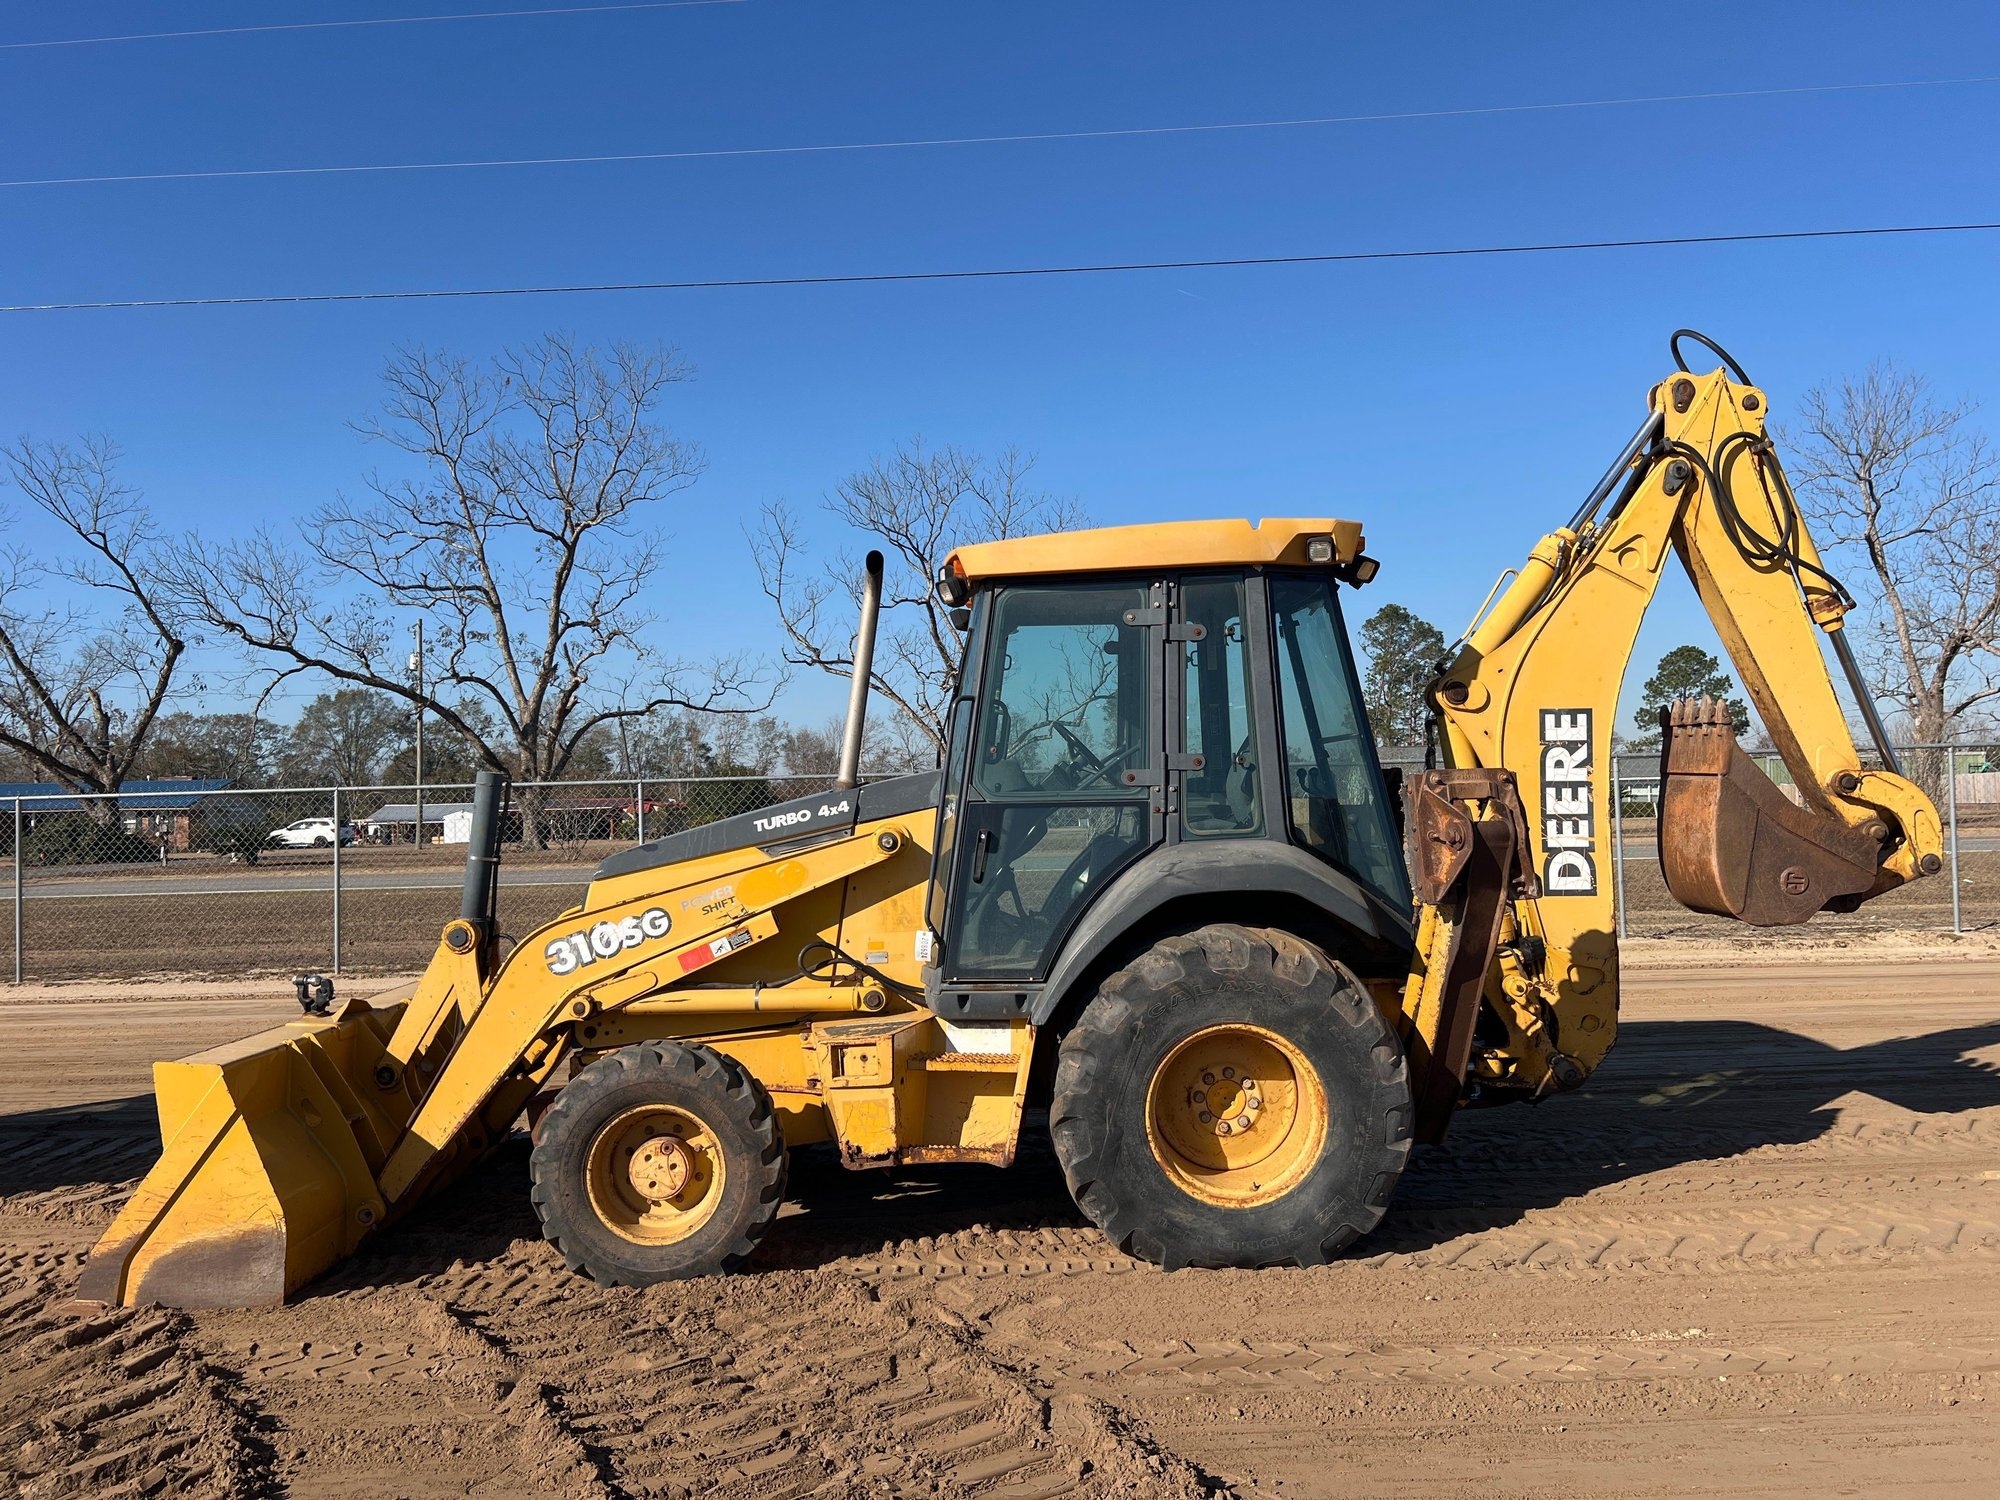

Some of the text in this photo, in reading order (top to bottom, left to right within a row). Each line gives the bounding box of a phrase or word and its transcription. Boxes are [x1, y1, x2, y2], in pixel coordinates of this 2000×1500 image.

[753, 800, 850, 832] TURBO 4x4
[1542, 711, 1595, 893] DEERE
[701, 896, 736, 916] SHIFT
[544, 907, 672, 976] 310SG
[1148, 980, 1297, 1018] GALAXY
